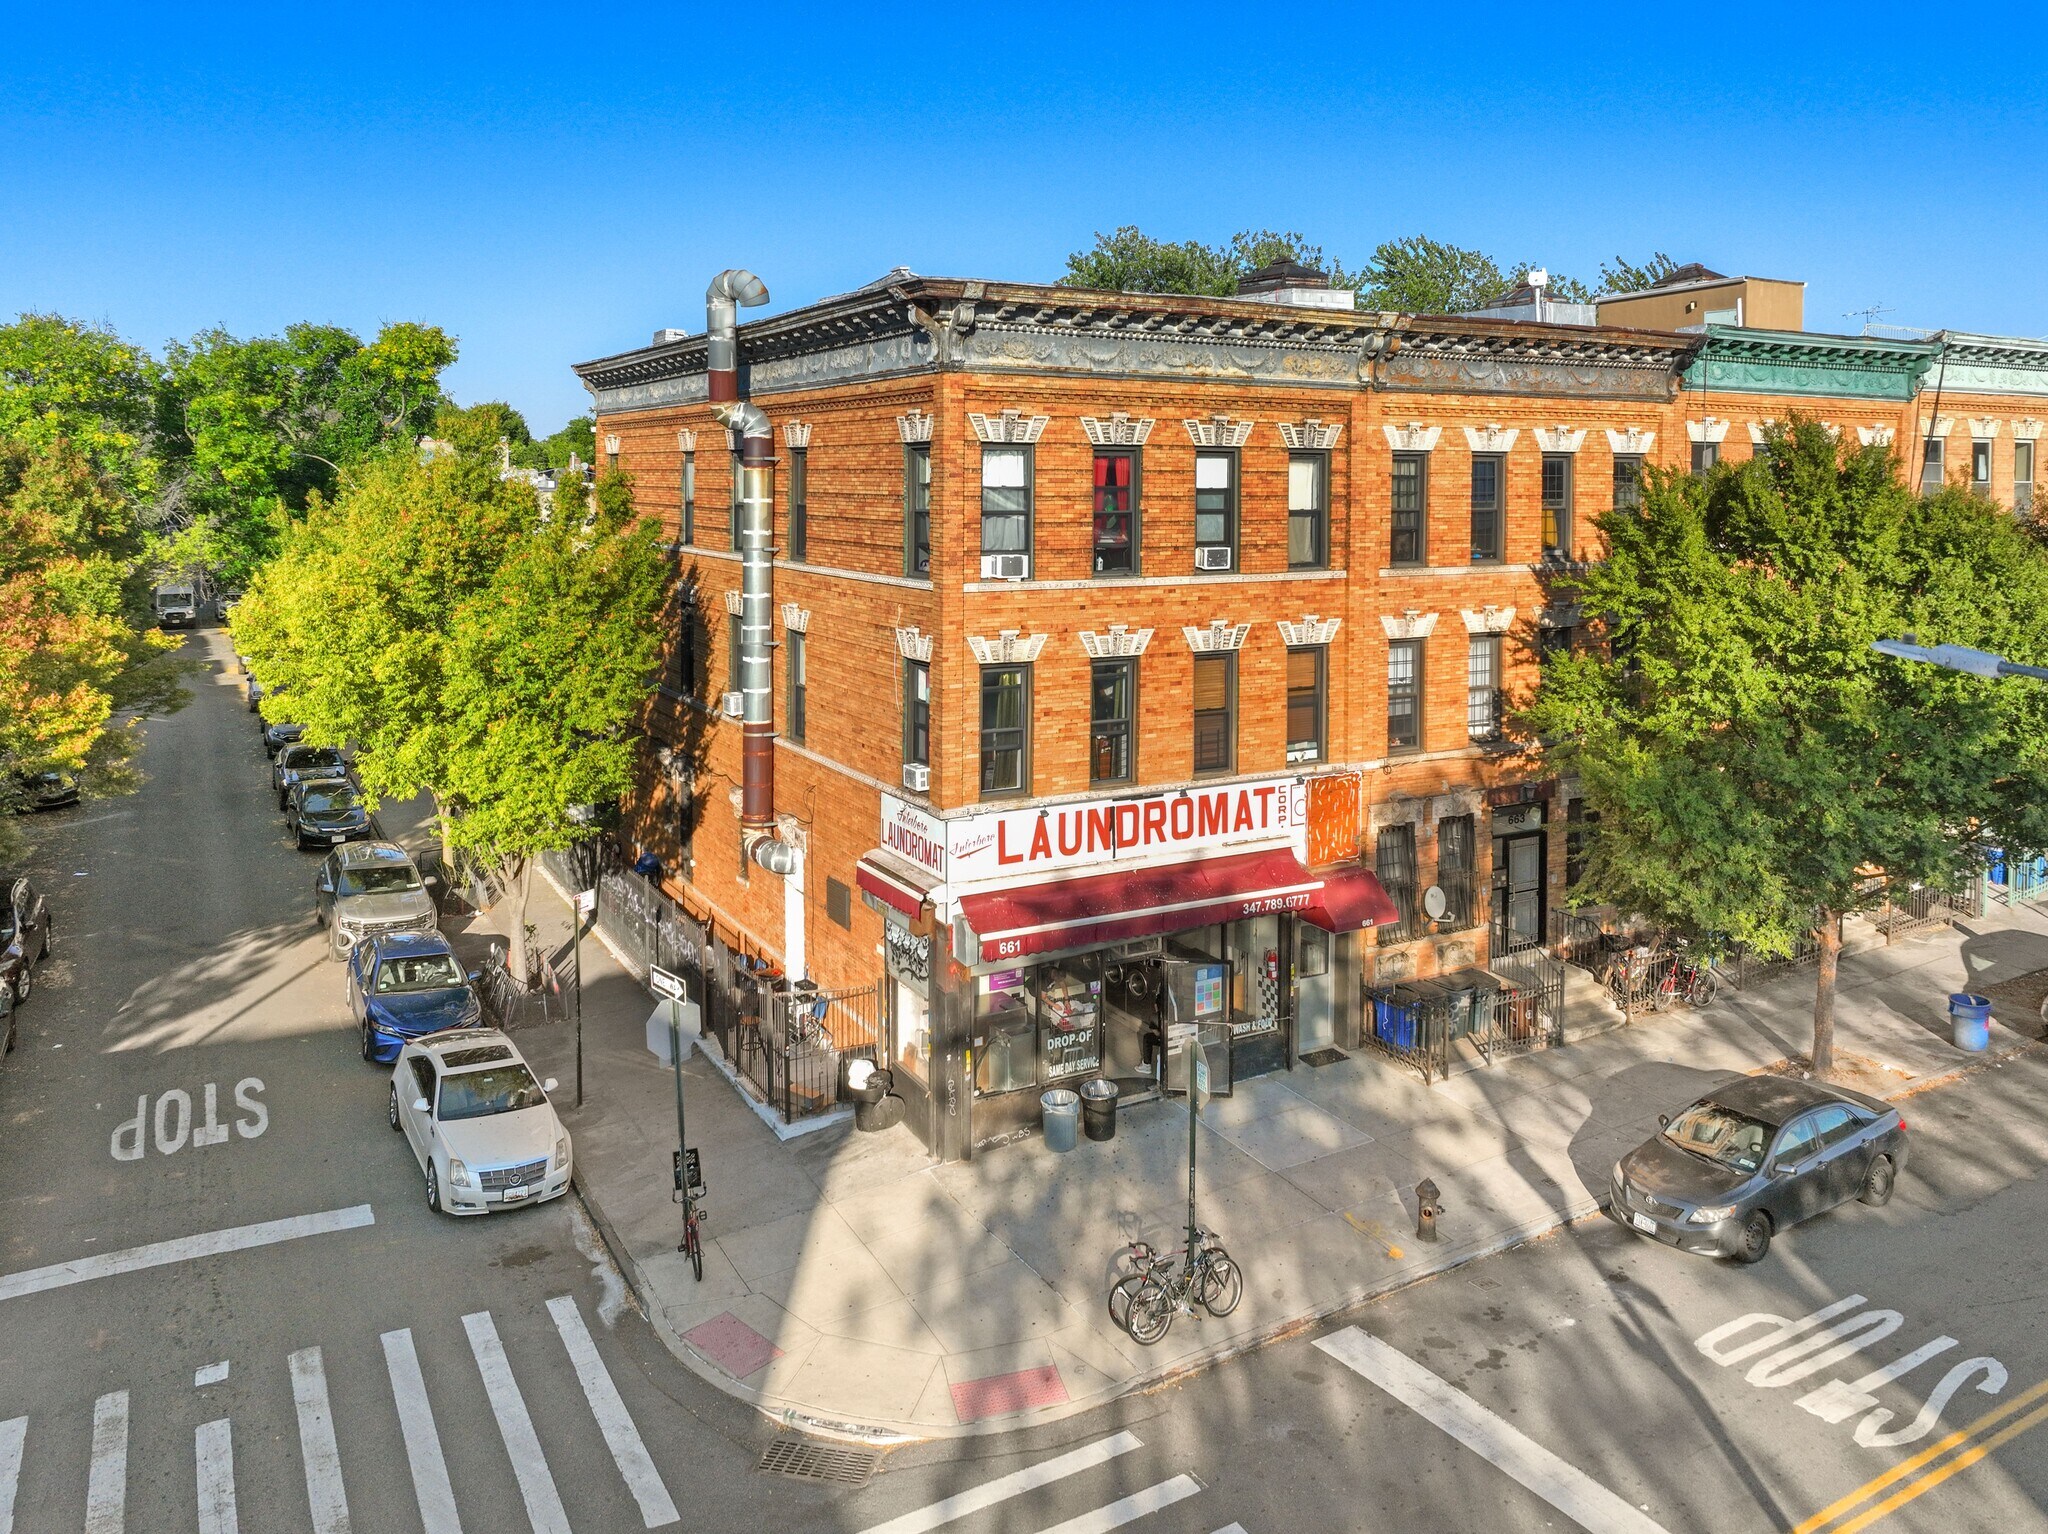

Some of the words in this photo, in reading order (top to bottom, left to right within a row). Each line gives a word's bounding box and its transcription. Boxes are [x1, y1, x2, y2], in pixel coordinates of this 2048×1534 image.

[997, 786, 1276, 866] LAUNDROMAT
[1508, 813, 1526, 825] 663
[881, 818, 945, 873] LAUNDROMAT
[1242, 893, 1310, 915] 347.789.6777
[1361, 918, 1374, 927] 661
[999, 939, 1021, 955] 661
[110, 1077, 270, 1162] STOP
[1694, 1294, 2009, 1448] STOP
